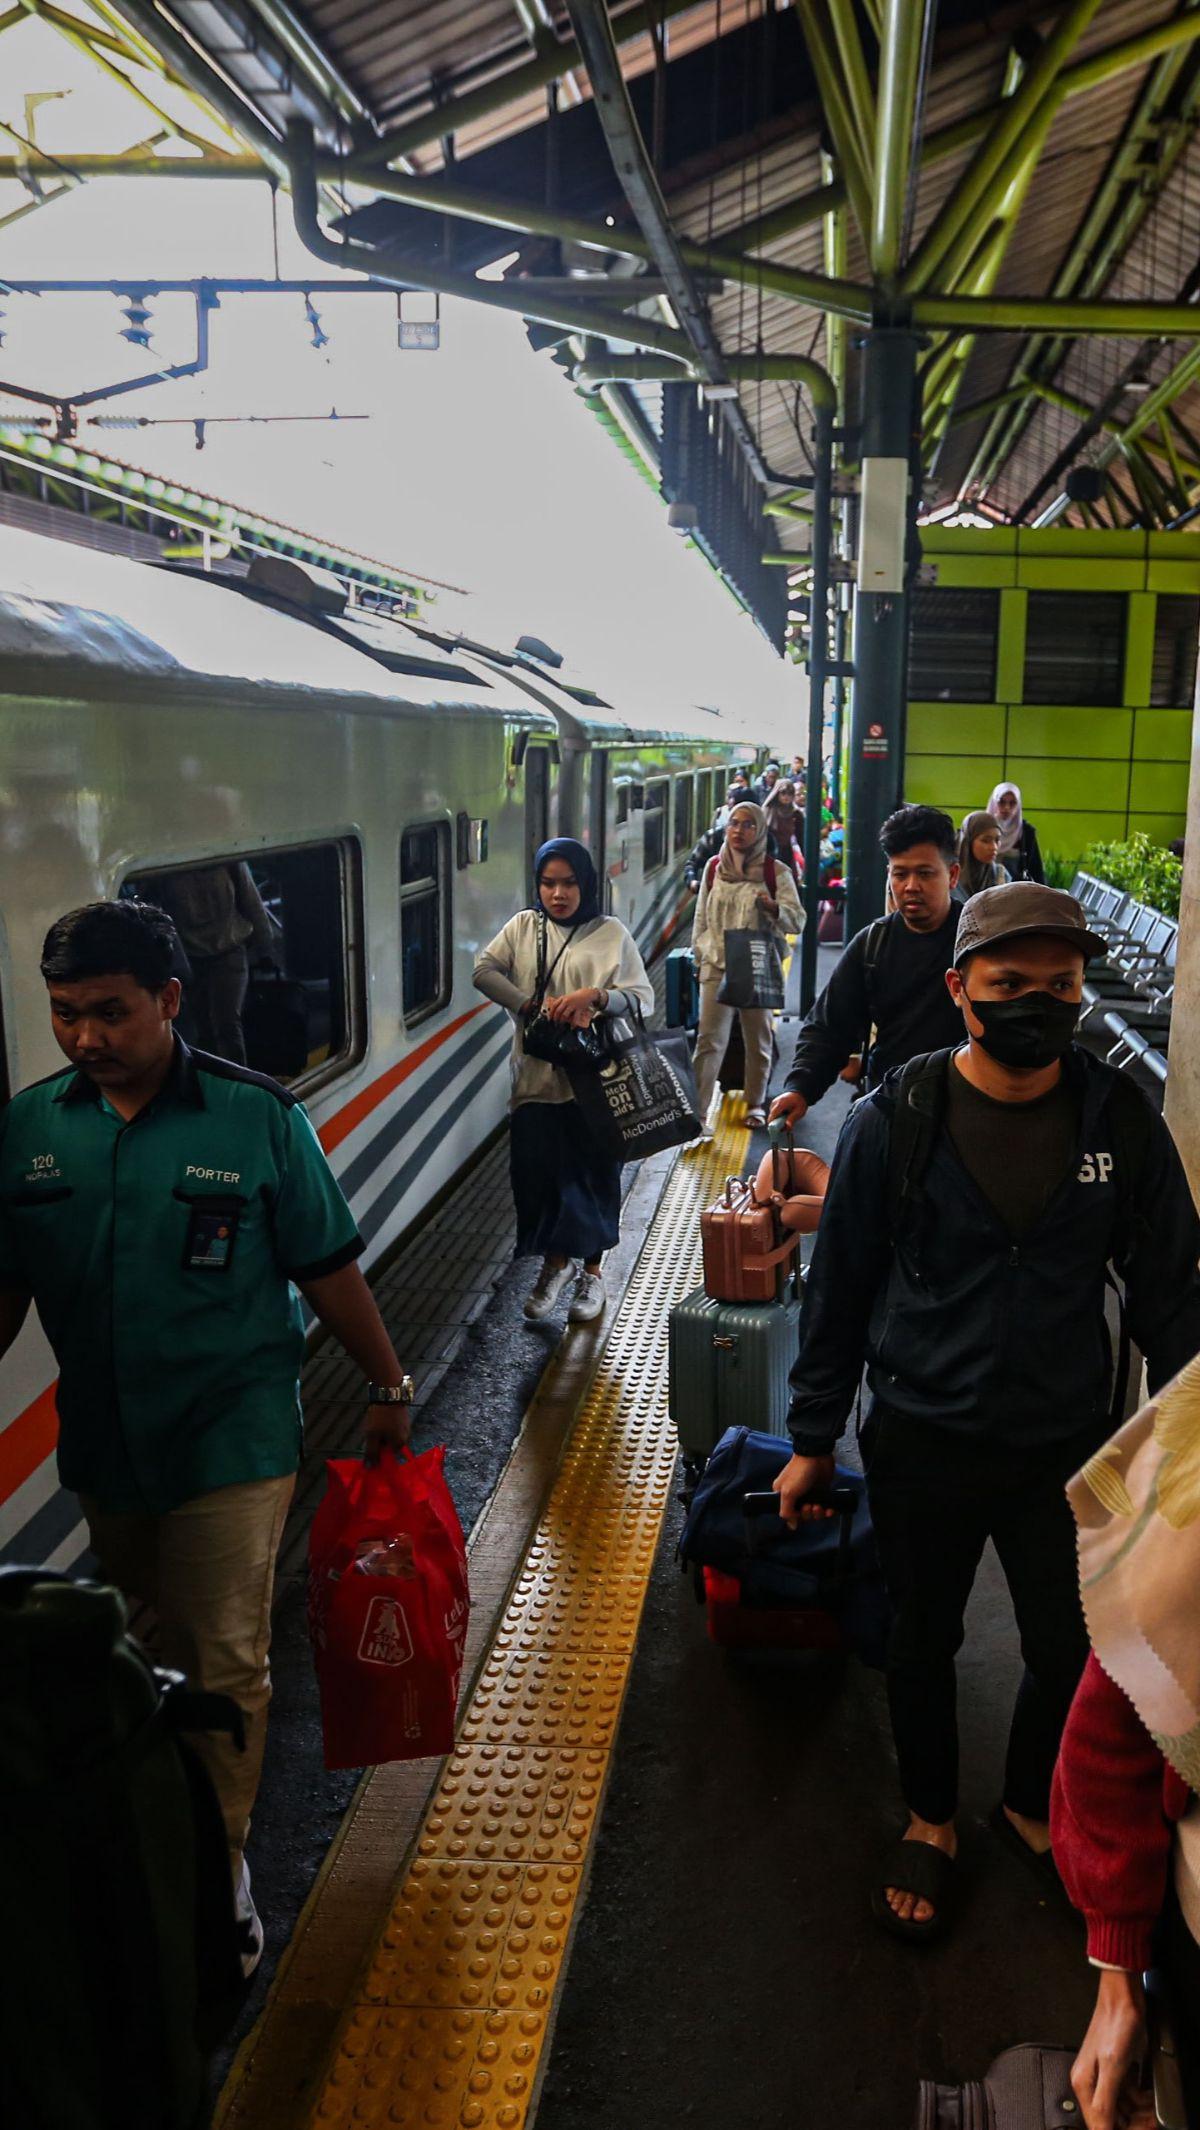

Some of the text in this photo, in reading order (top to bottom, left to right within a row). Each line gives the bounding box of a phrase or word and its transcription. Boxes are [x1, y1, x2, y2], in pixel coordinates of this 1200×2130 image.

[605, 1082, 627, 1098] McD
[608, 1091, 632, 1108] on
[622, 1108, 682, 1141] McDonald's
[32, 1153, 54, 1170] 120
[1077, 1152, 1113, 1183] SP
[186, 1165, 240, 1183] PORTER
